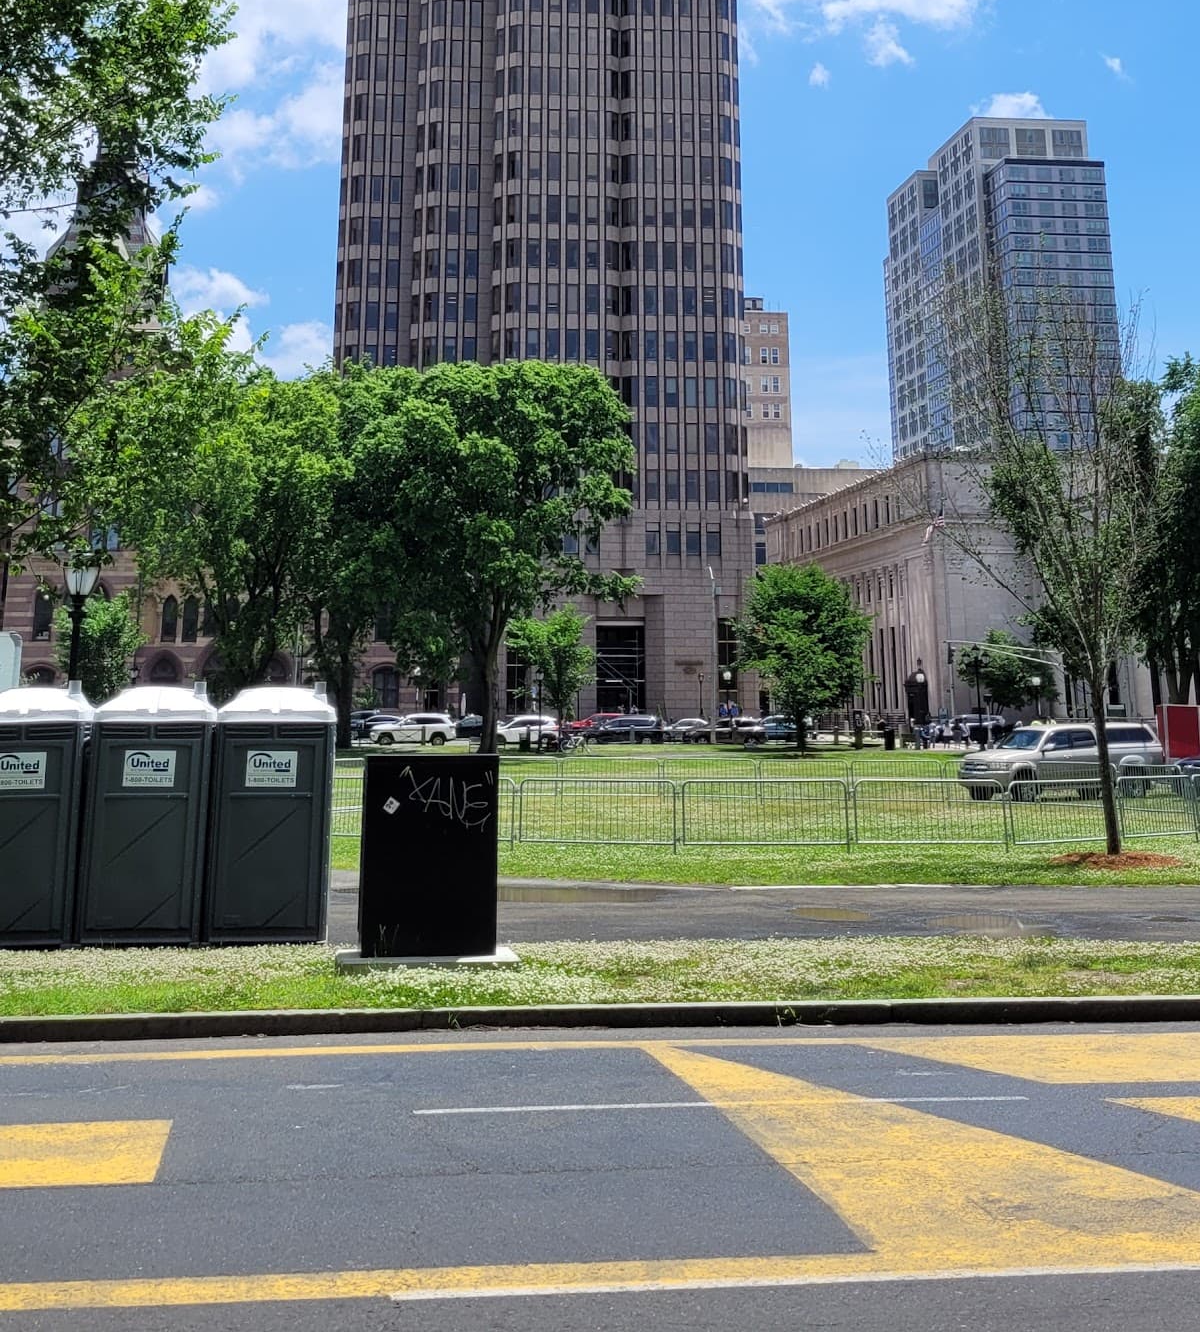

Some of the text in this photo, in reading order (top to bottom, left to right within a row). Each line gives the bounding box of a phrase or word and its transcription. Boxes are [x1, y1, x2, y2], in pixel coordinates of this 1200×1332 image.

[1, 760, 40, 770] United
[131, 758, 170, 768] United
[253, 758, 291, 768] United
